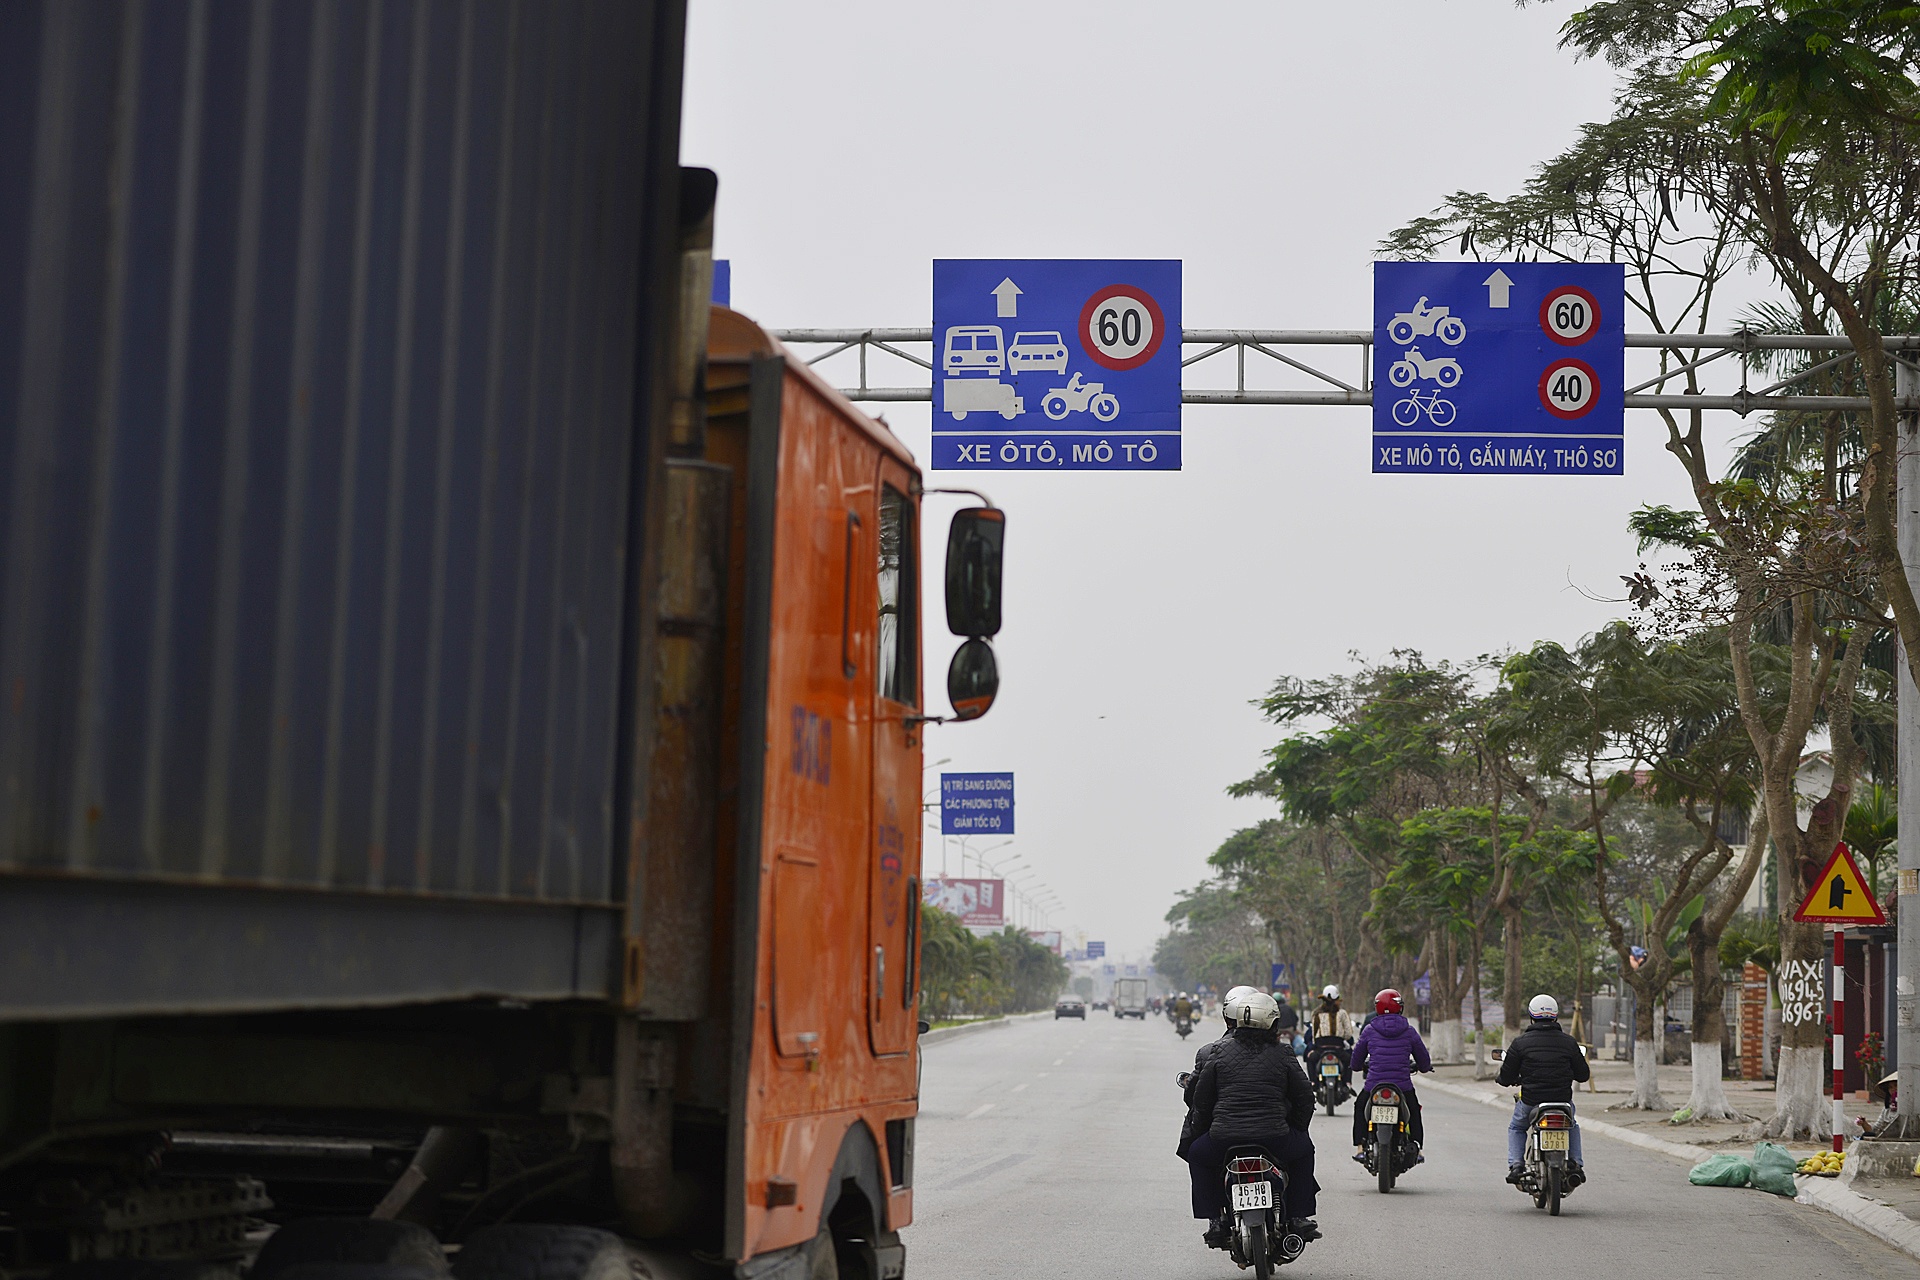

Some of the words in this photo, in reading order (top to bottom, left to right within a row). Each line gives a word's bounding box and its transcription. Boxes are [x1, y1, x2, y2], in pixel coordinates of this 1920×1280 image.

[1098, 308, 1141, 347] 60
[1555, 302, 1585, 330] 60
[1552, 374, 1582, 402] 40
[956, 443, 991, 463] XE
[999, 439, 1064, 465] ÔTÔ,
[1072, 439, 1114, 463] MÔ
[1121, 439, 1158, 463] TÔ
[1379, 447, 1402, 466] XE
[1406, 442, 1433, 466] MÔ
[1437, 443, 1463, 470] TÔ,
[1469, 441, 1506, 467] GẮN
[1509, 444, 1547, 470] MÁY,
[1553, 445, 1589, 468] THÔ
[1592, 448, 1617, 469] SƠ
[964, 779, 985, 791] SANG
[944, 797, 961, 810] CÁC
[1239, 1195, 1267, 1208] 4428
